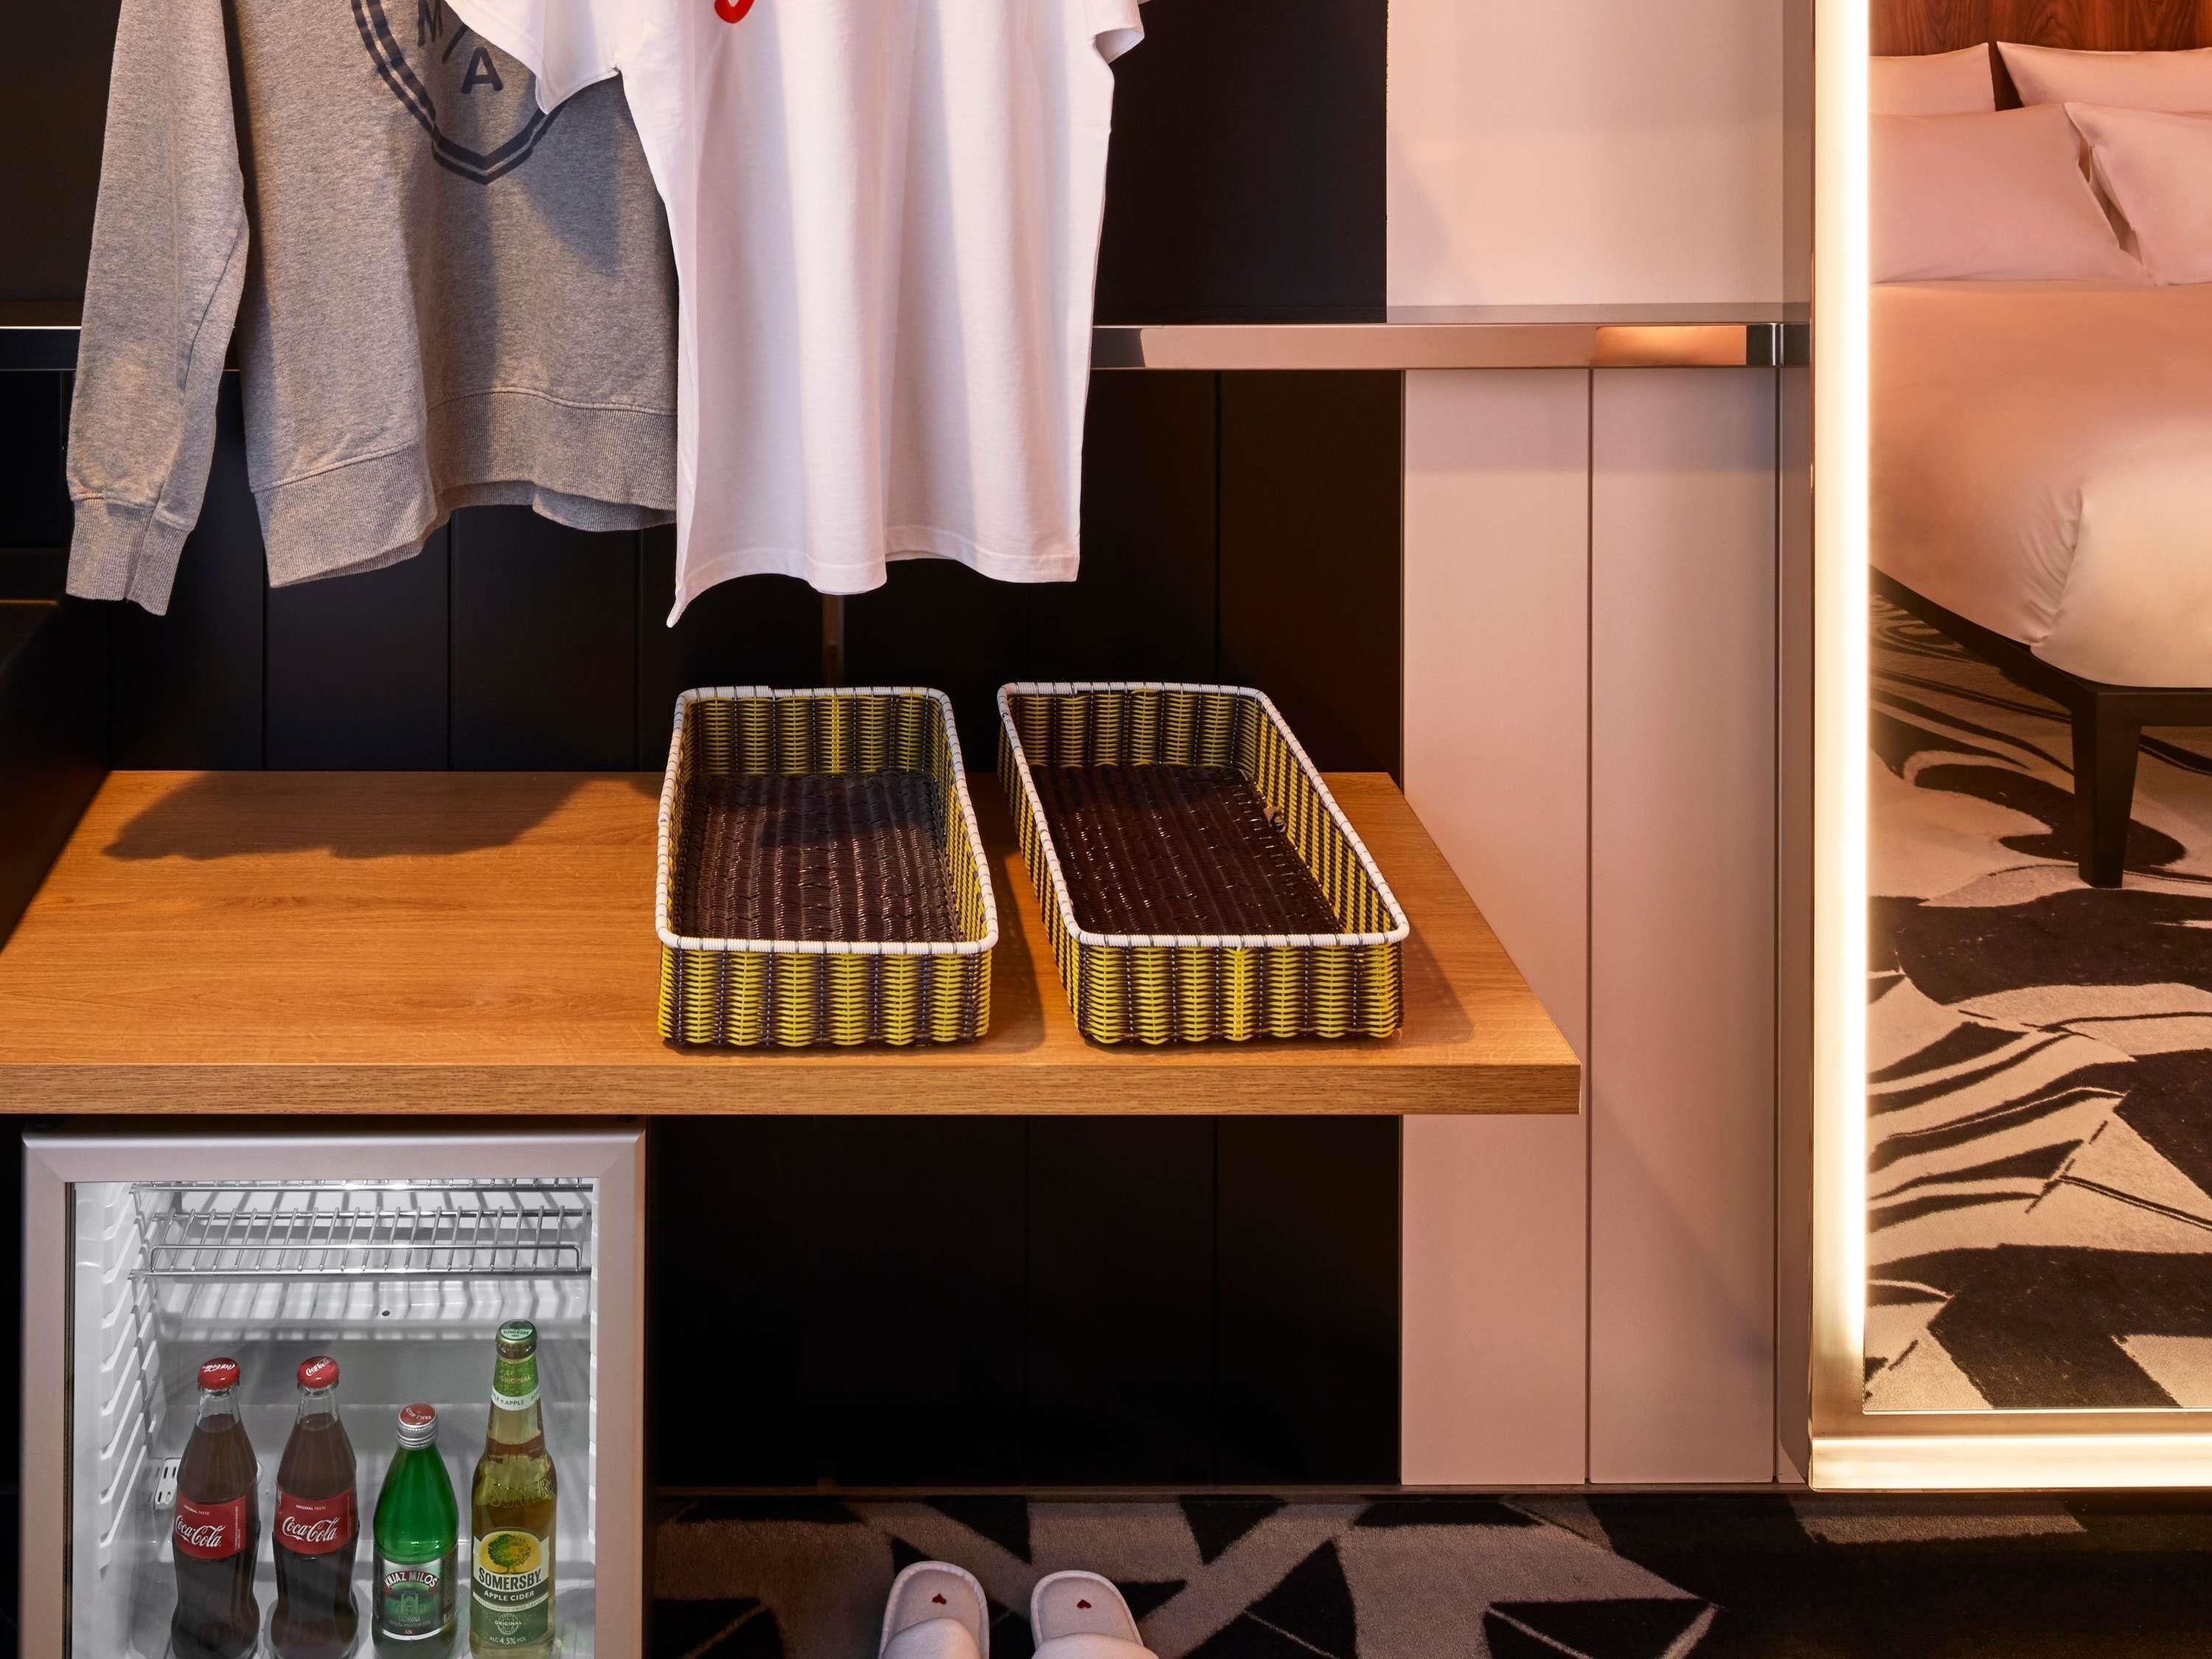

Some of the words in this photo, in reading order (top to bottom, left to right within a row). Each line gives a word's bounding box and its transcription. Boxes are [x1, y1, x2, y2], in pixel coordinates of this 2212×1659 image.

[175, 1514, 226, 1548] Coca-Cola
[282, 1516, 341, 1543] Coca-Cola
[384, 1572, 406, 1588] KNJAZ
[479, 1566, 541, 1590] SOMERSBY
[484, 1590, 507, 1601] APPLE
[510, 1590, 535, 1601] CIDER
